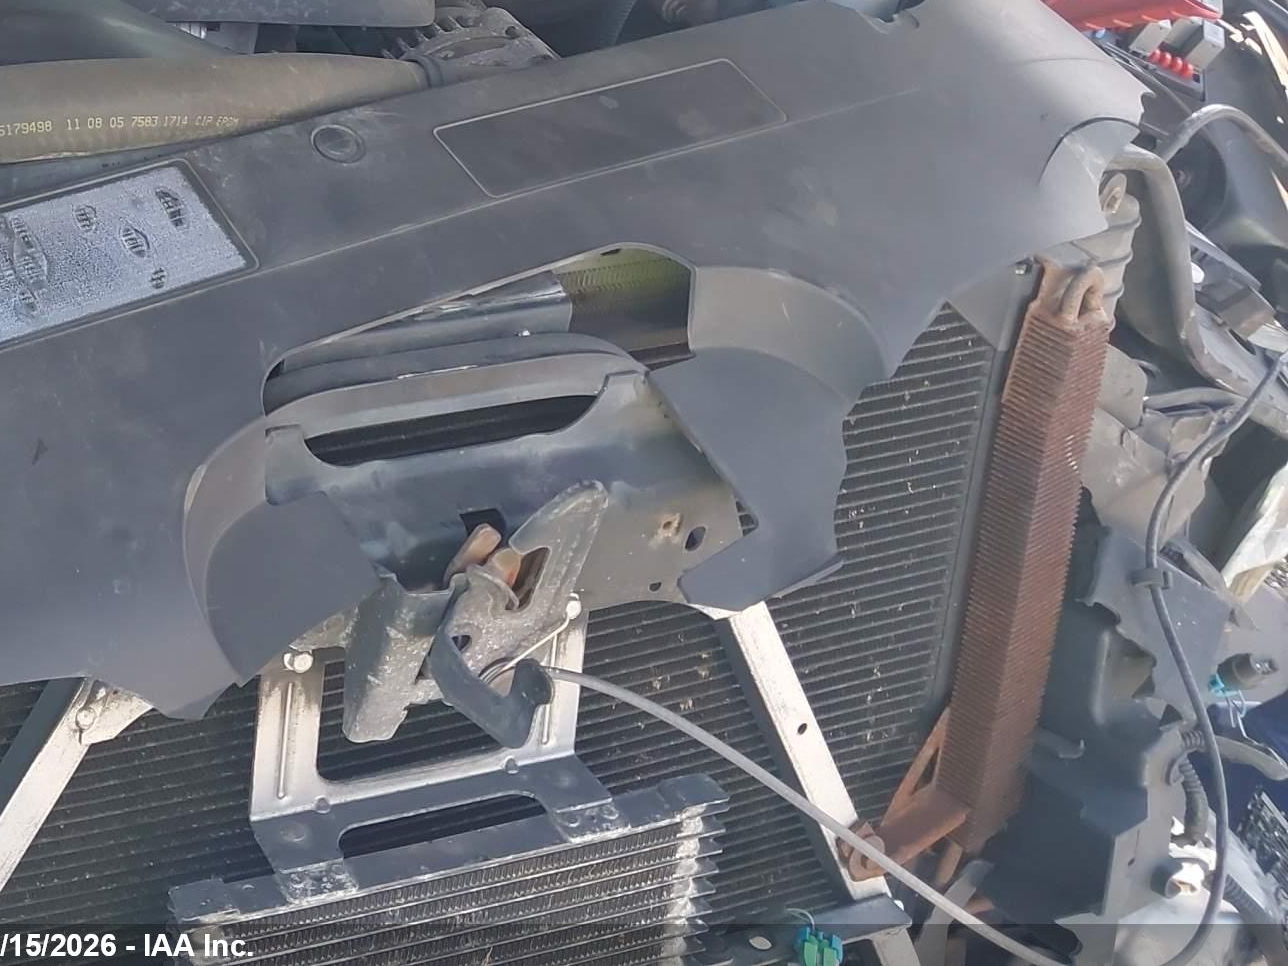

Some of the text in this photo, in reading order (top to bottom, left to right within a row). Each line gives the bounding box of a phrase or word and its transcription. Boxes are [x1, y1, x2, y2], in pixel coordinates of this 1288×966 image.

[66, 118, 81, 131] 11
[87, 117, 103, 130] 08
[109, 116, 124, 129] 05
[131, 115, 159, 128] 7583
[162, 115, 189, 127] 1714
